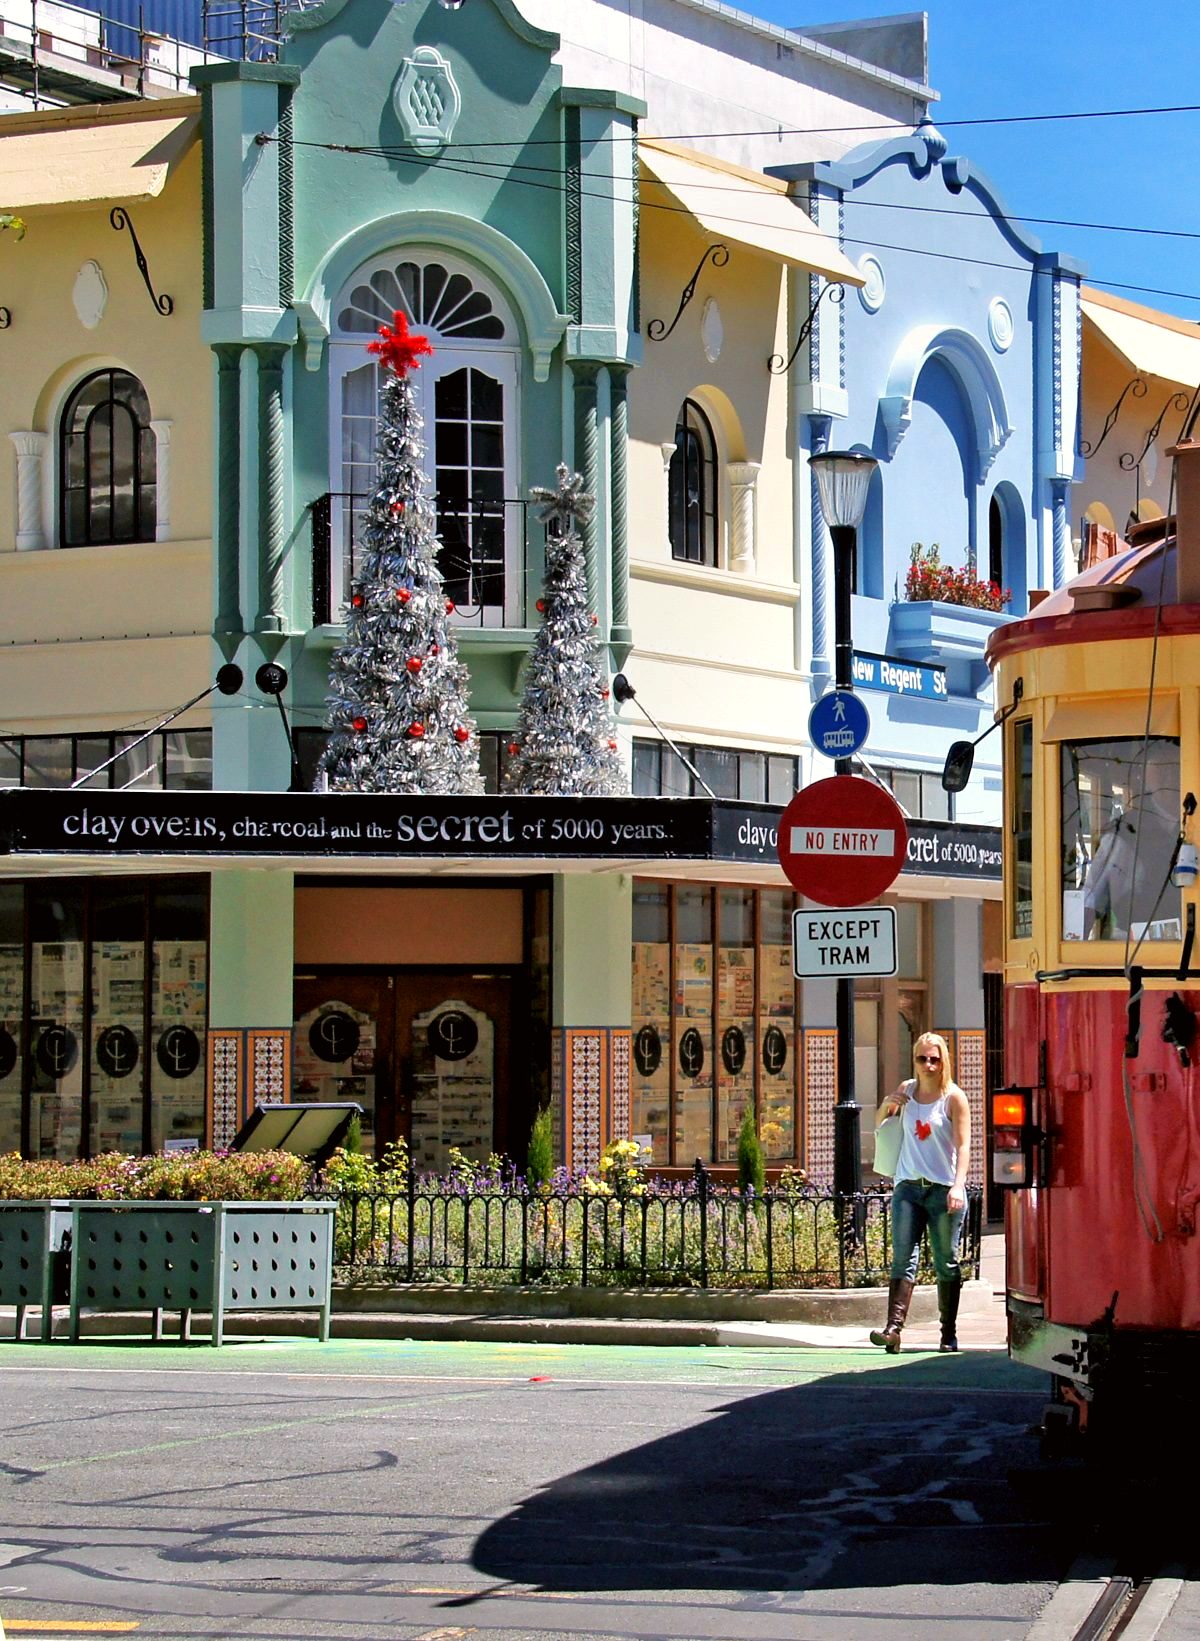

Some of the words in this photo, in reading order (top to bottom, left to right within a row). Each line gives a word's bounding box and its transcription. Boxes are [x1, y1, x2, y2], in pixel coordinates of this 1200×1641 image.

[880, 660, 922, 693] Regent
[933, 671, 947, 694] St
[63, 808, 127, 843] clay
[232, 816, 326, 838] charcoal
[331, 822, 361, 840] and
[366, 823, 392, 838] the
[397, 810, 515, 843] secret
[521, 819, 545, 839] of
[551, 819, 604, 839] 5000
[738, 818, 768, 853] clay
[806, 832, 824, 849] NO
[833, 833, 879, 851] ENTRY
[906, 834, 940, 863] cret
[941, 842, 953, 861] of
[954, 843, 977, 862] 5000
[808, 920, 880, 940] EXCEPT
[818, 946, 870, 965] TRAM
